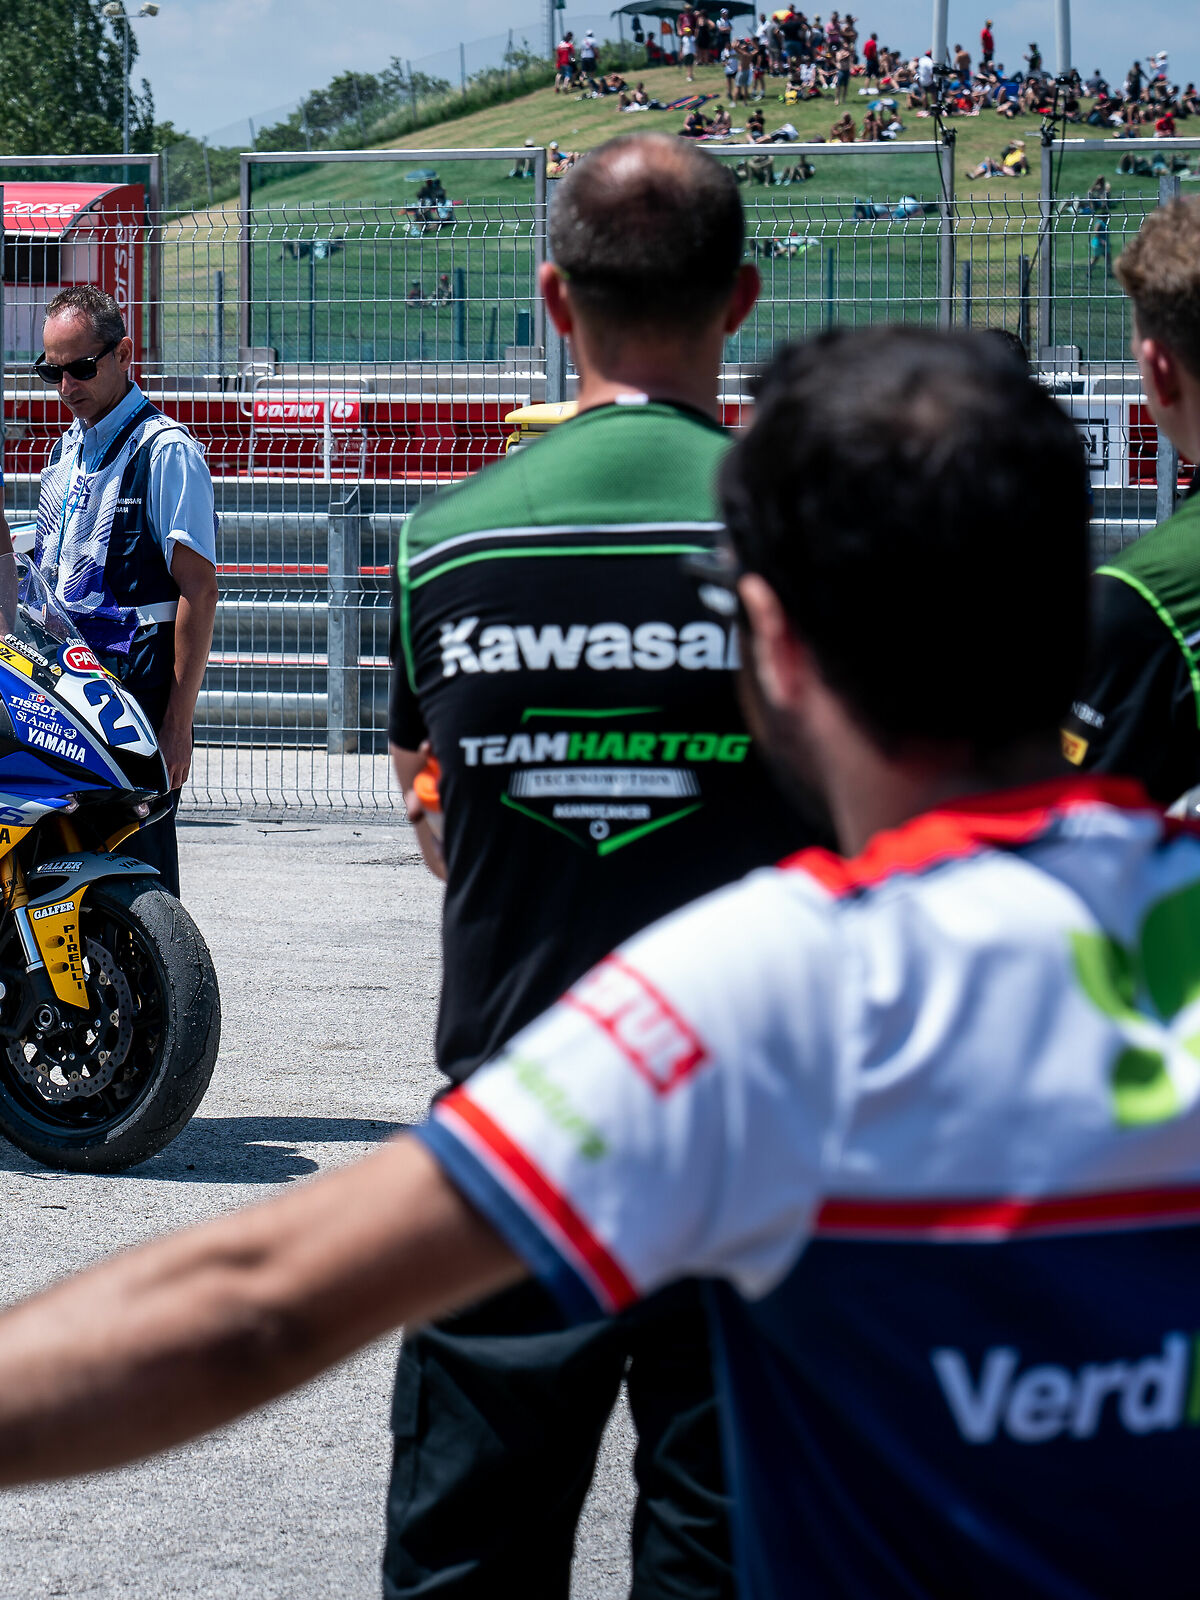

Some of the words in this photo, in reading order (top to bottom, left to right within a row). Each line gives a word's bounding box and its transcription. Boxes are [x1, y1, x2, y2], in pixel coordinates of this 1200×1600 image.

[3, 200, 81, 213] Corse
[11, 695, 60, 716] TISSOT
[15, 710, 28, 723] Si
[27, 715, 63, 736] Anelli
[28, 727, 86, 763] YAMAHA
[33, 901, 75, 920] GALFER
[63, 924, 83, 990] PIRELLI
[933, 1332, 1200, 1443] Verd
